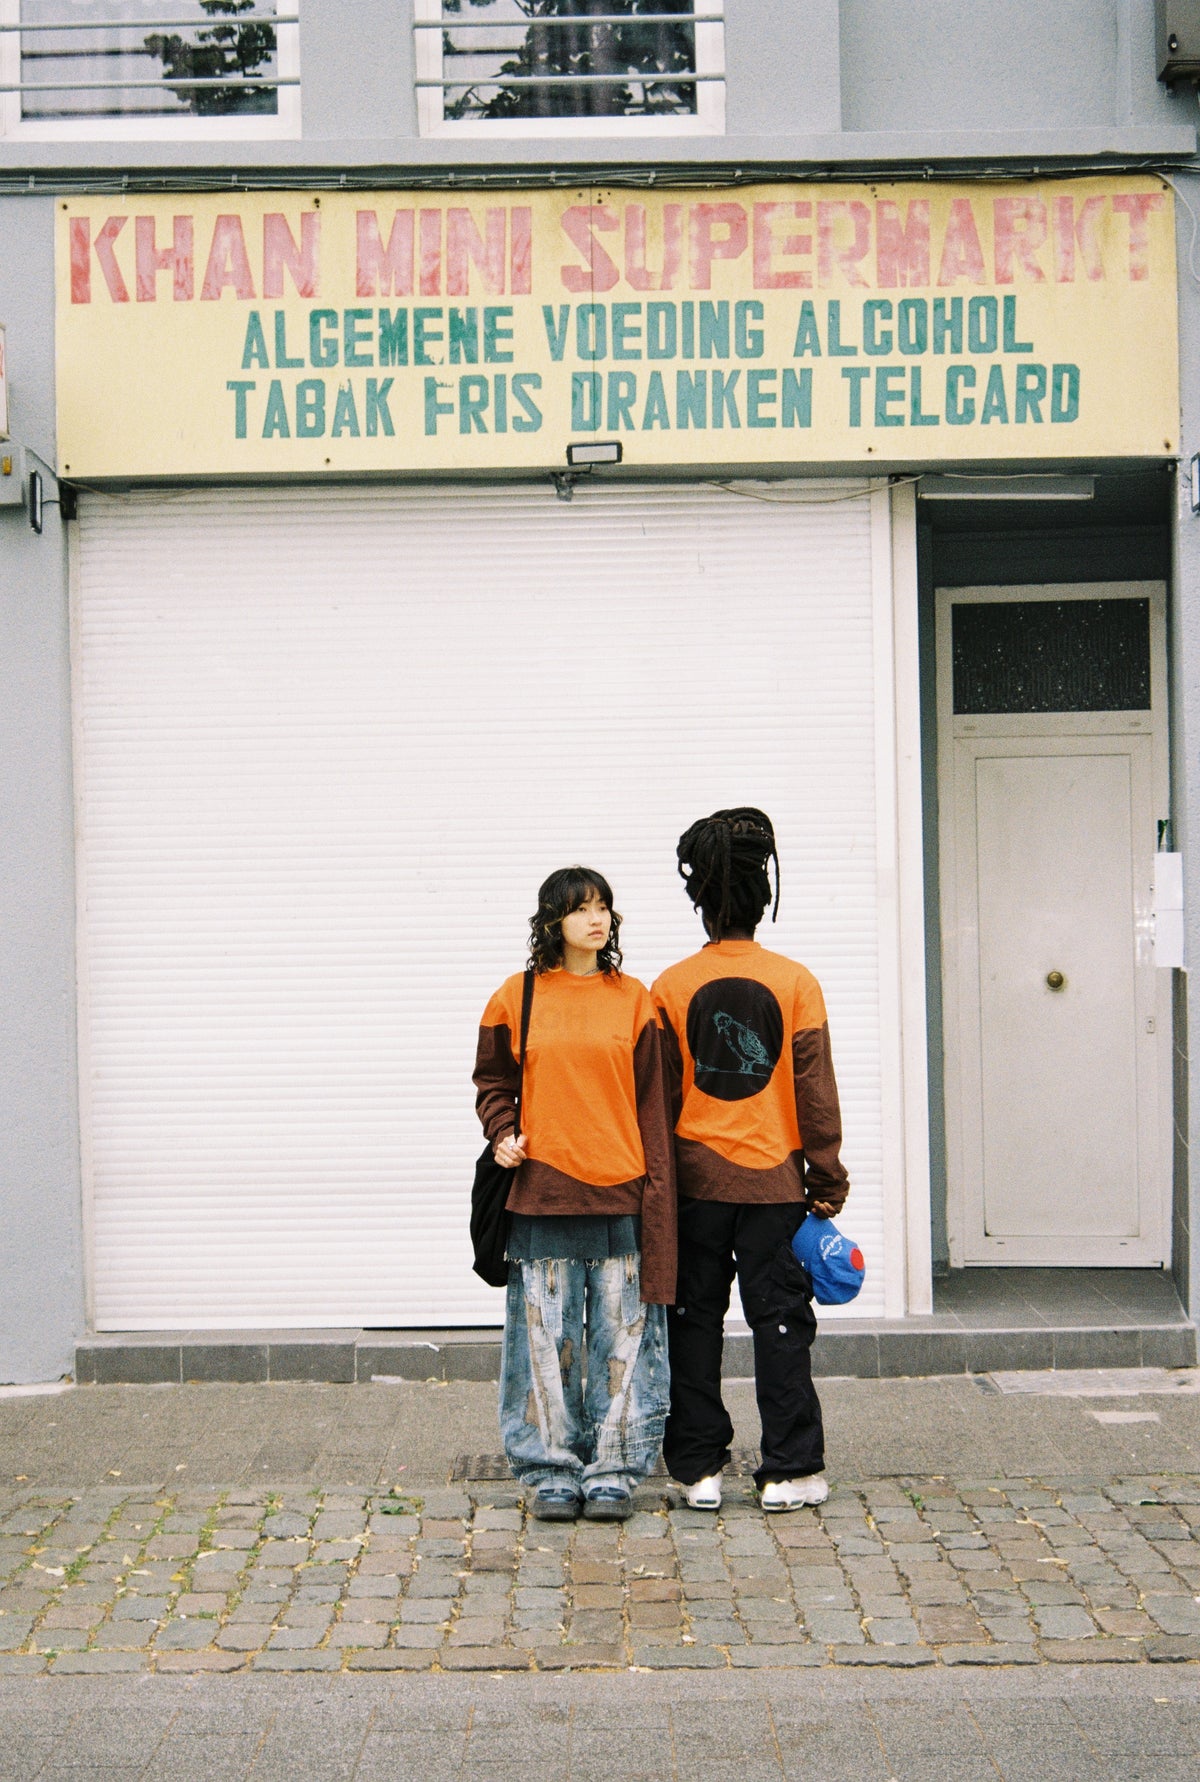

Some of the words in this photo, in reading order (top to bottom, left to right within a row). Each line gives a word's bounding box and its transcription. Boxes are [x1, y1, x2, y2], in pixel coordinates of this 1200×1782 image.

[69, 212, 321, 304] KHAN
[355, 206, 533, 298] MINI
[560, 193, 1167, 293] SUPERMARKT
[241, 305, 515, 369] ALGEMENE
[542, 299, 765, 361] VOEDING
[794, 294, 1034, 358] ALCOHOL
[226, 378, 396, 439] TABAK
[424, 372, 544, 437] FRIS
[571, 367, 813, 431] DRANKEN
[841, 363, 1081, 427] TELCARD
